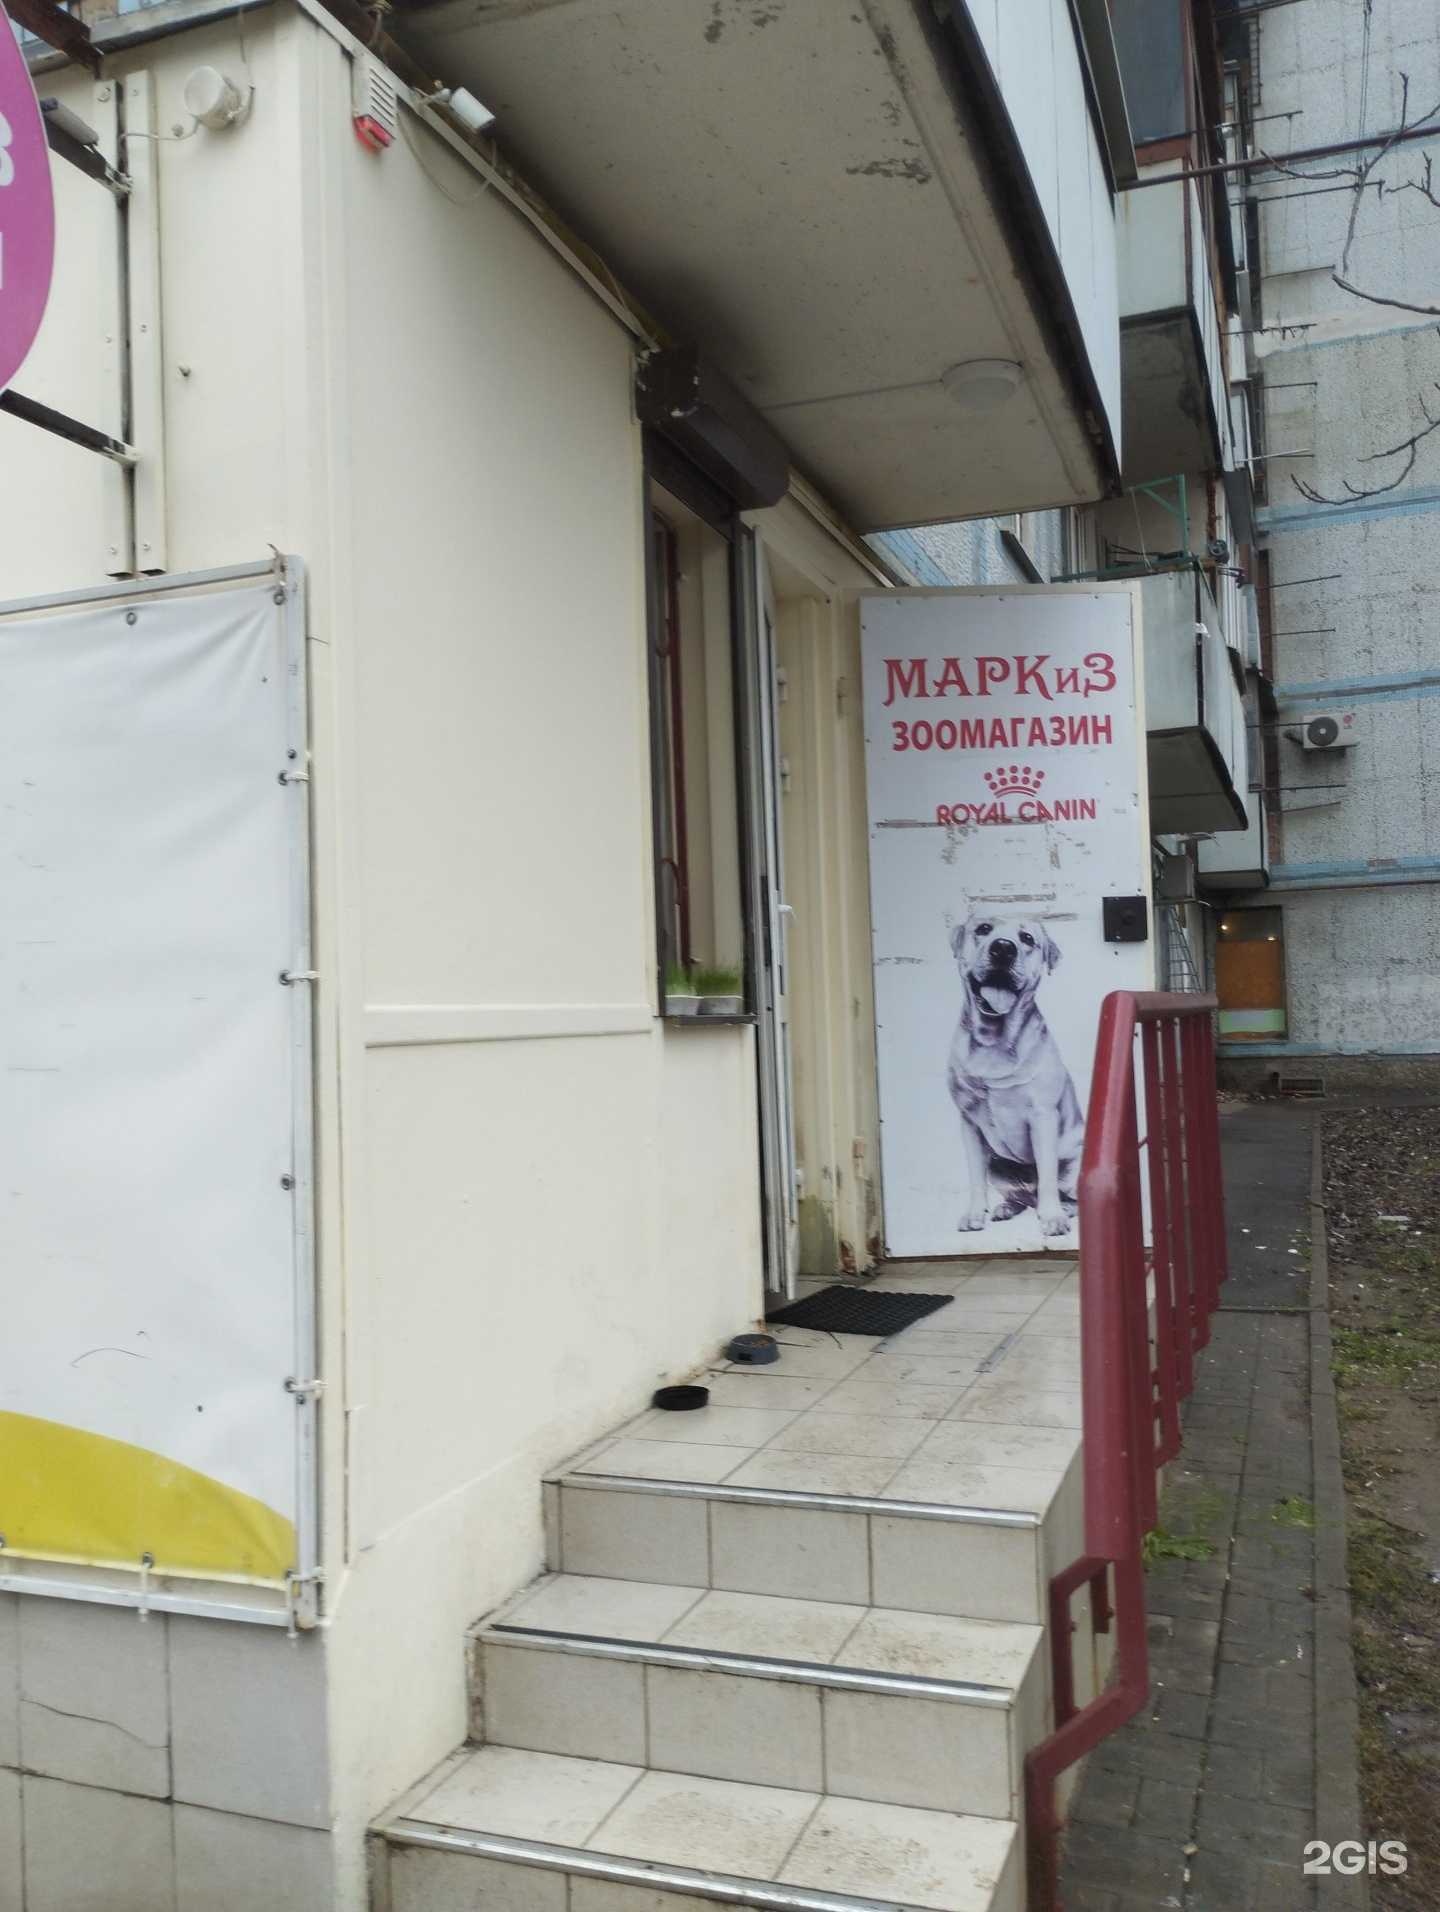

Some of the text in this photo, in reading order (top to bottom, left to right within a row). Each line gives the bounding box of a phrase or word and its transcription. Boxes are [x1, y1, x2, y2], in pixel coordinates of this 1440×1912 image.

[892, 714, 1113, 752] ЗООМАГАЗИН
[935, 798, 1097, 826] ROYAL CANIN
